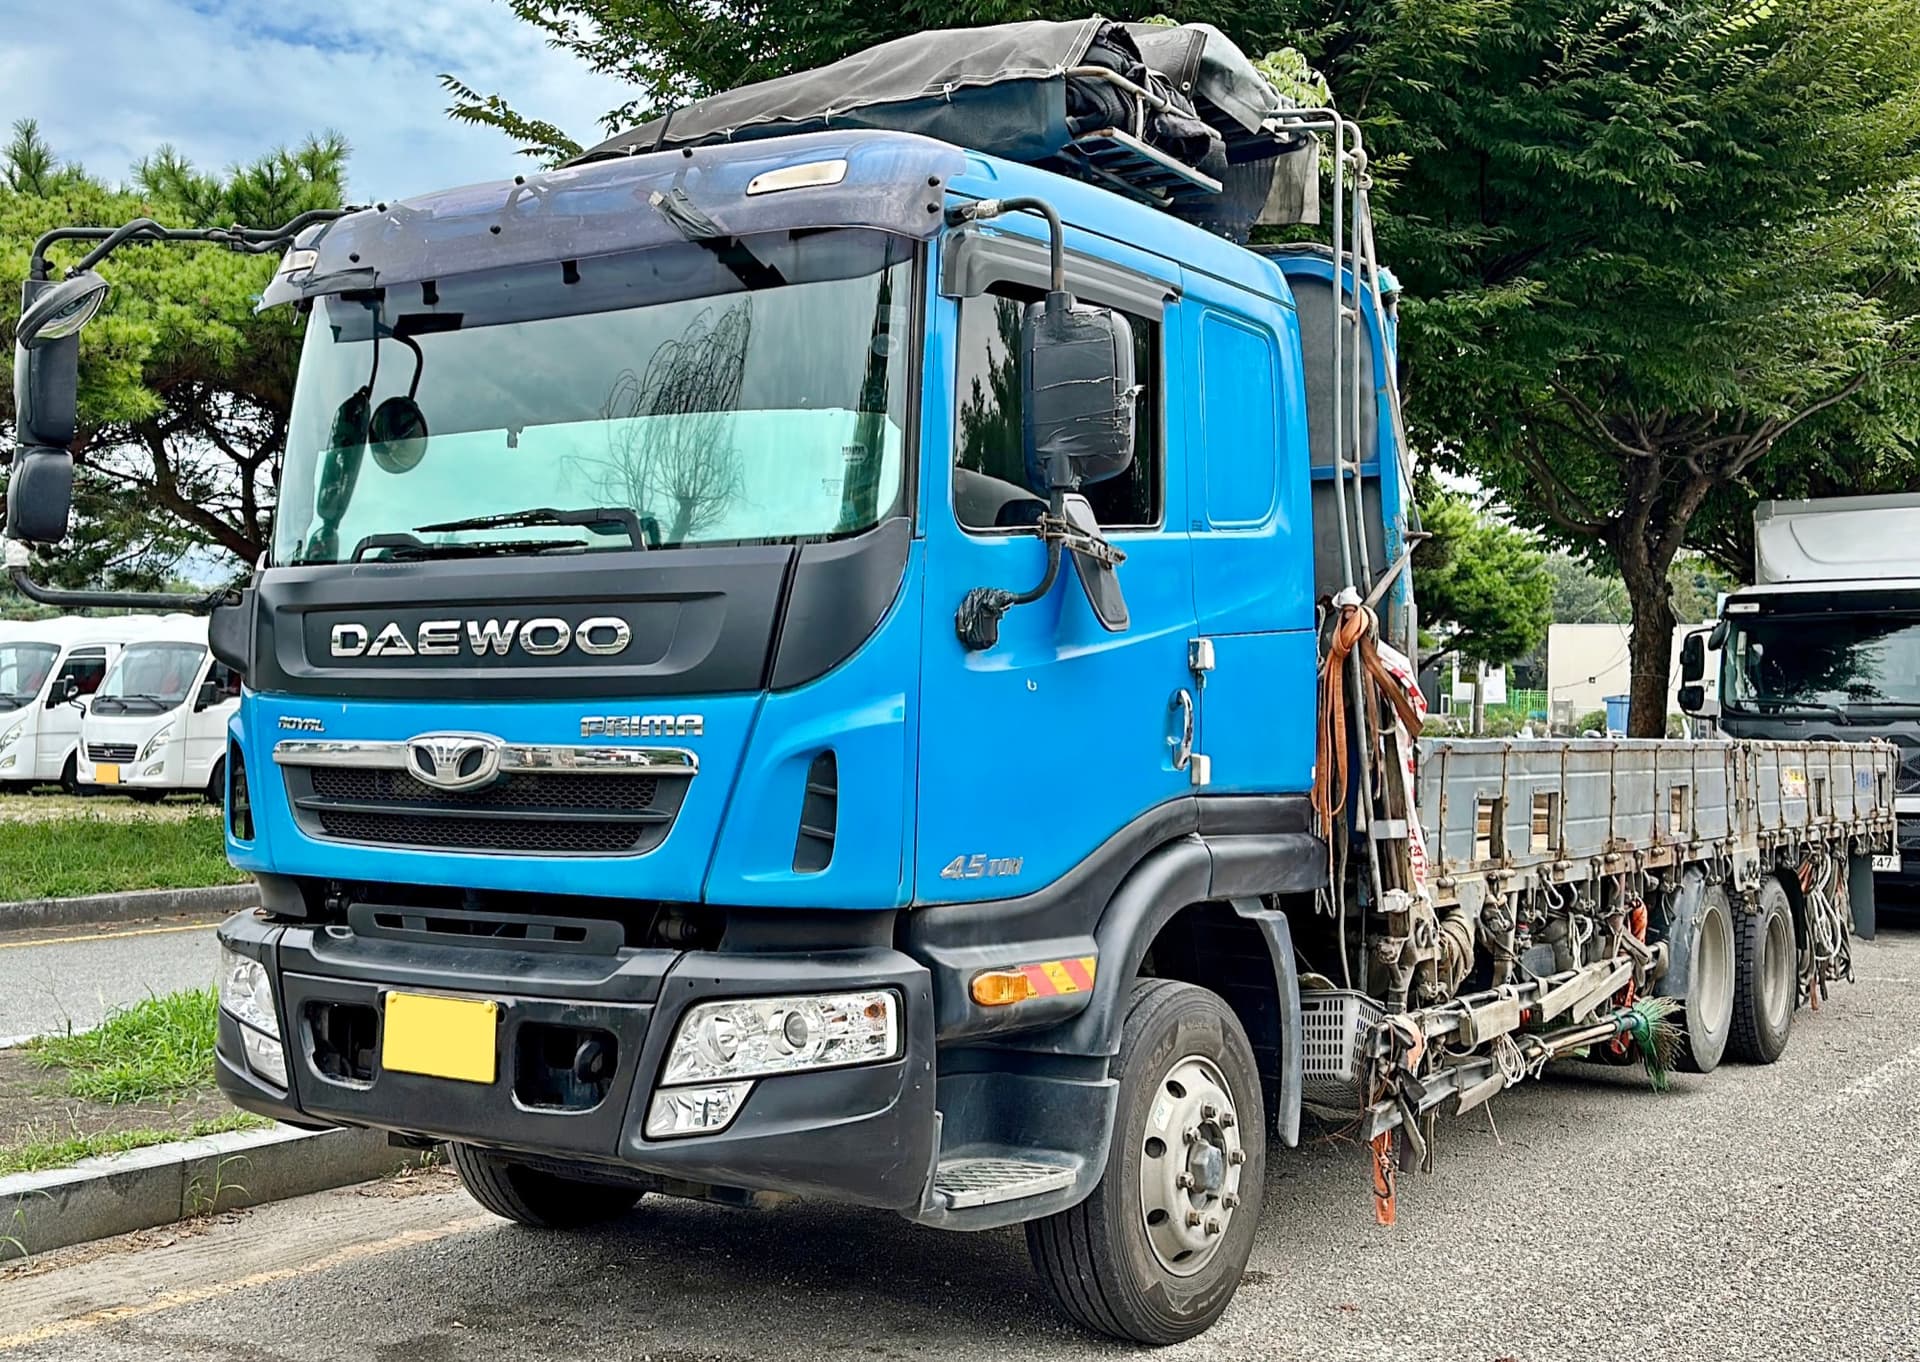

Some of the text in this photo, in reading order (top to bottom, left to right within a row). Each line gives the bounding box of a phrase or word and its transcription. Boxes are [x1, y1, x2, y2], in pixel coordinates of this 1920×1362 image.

[330, 617, 632, 657] DAEWOO
[278, 715, 325, 732] ROYAL
[580, 714, 704, 737] PRIMA
[940, 854, 1024, 879] 4.5 TON
